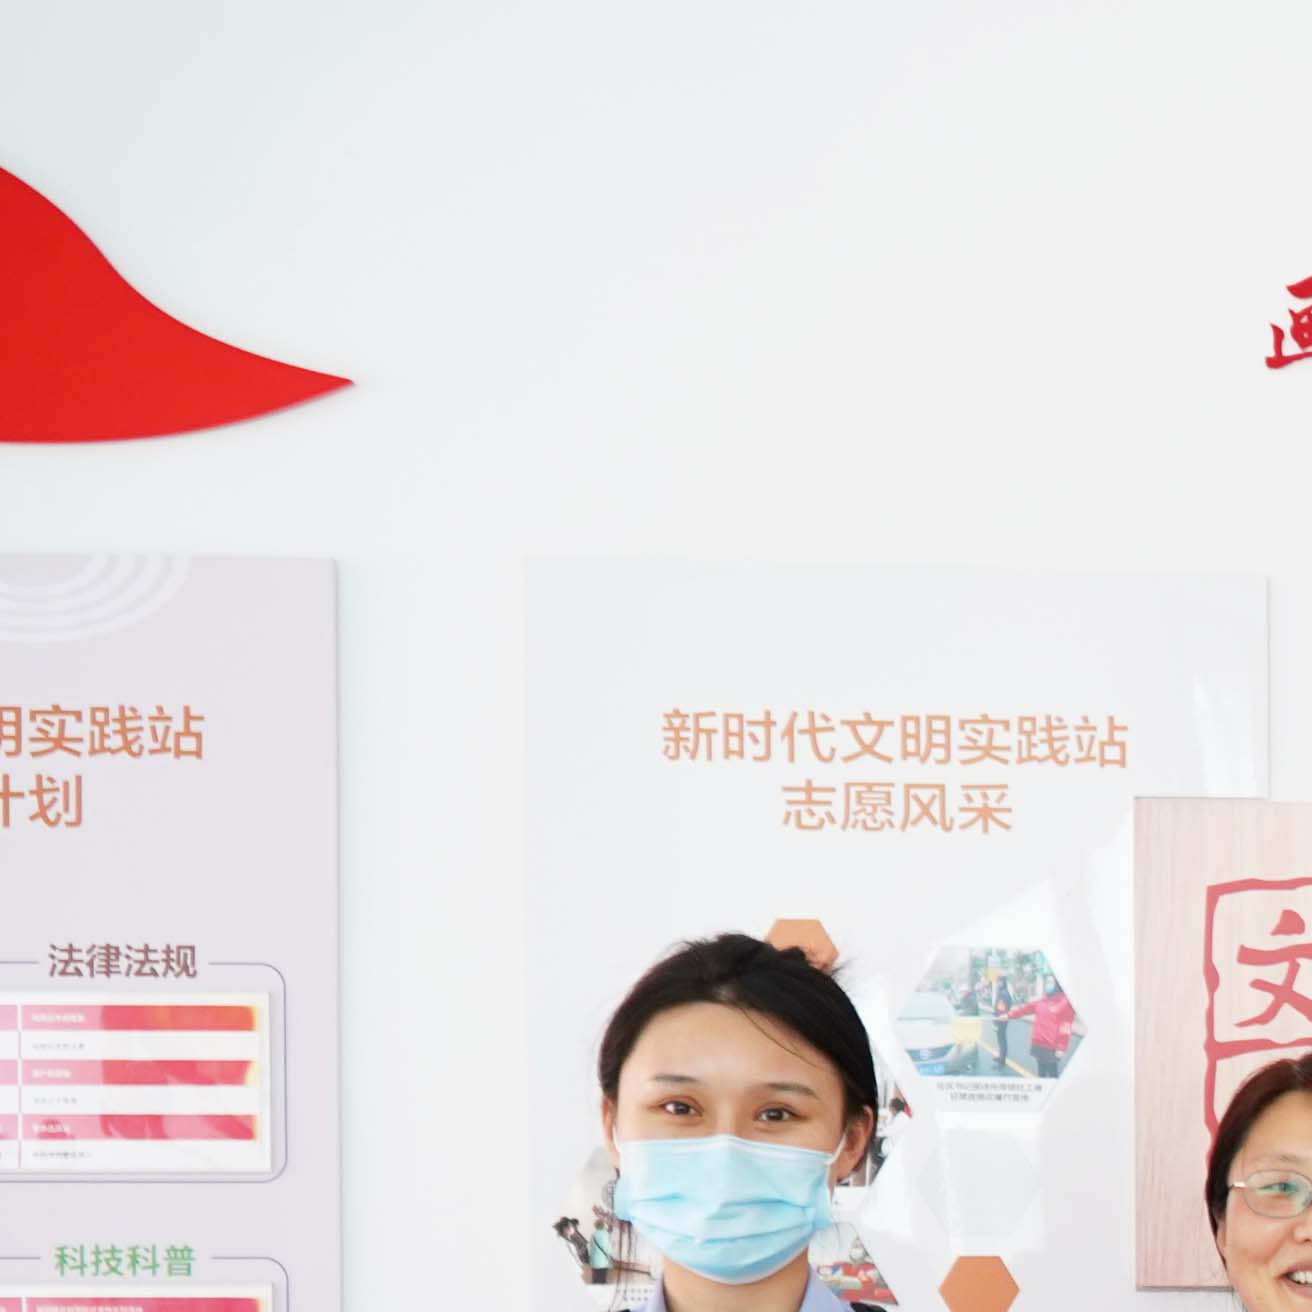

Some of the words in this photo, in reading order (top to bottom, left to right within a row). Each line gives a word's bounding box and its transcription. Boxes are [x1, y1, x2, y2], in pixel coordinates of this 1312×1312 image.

[661, 709, 1129, 768] 新时代文明实践站
[781, 779, 1013, 834] 志愿风采
[48, 943, 197, 978] 法律法规
[54, 1244, 196, 1278] 科技科普
